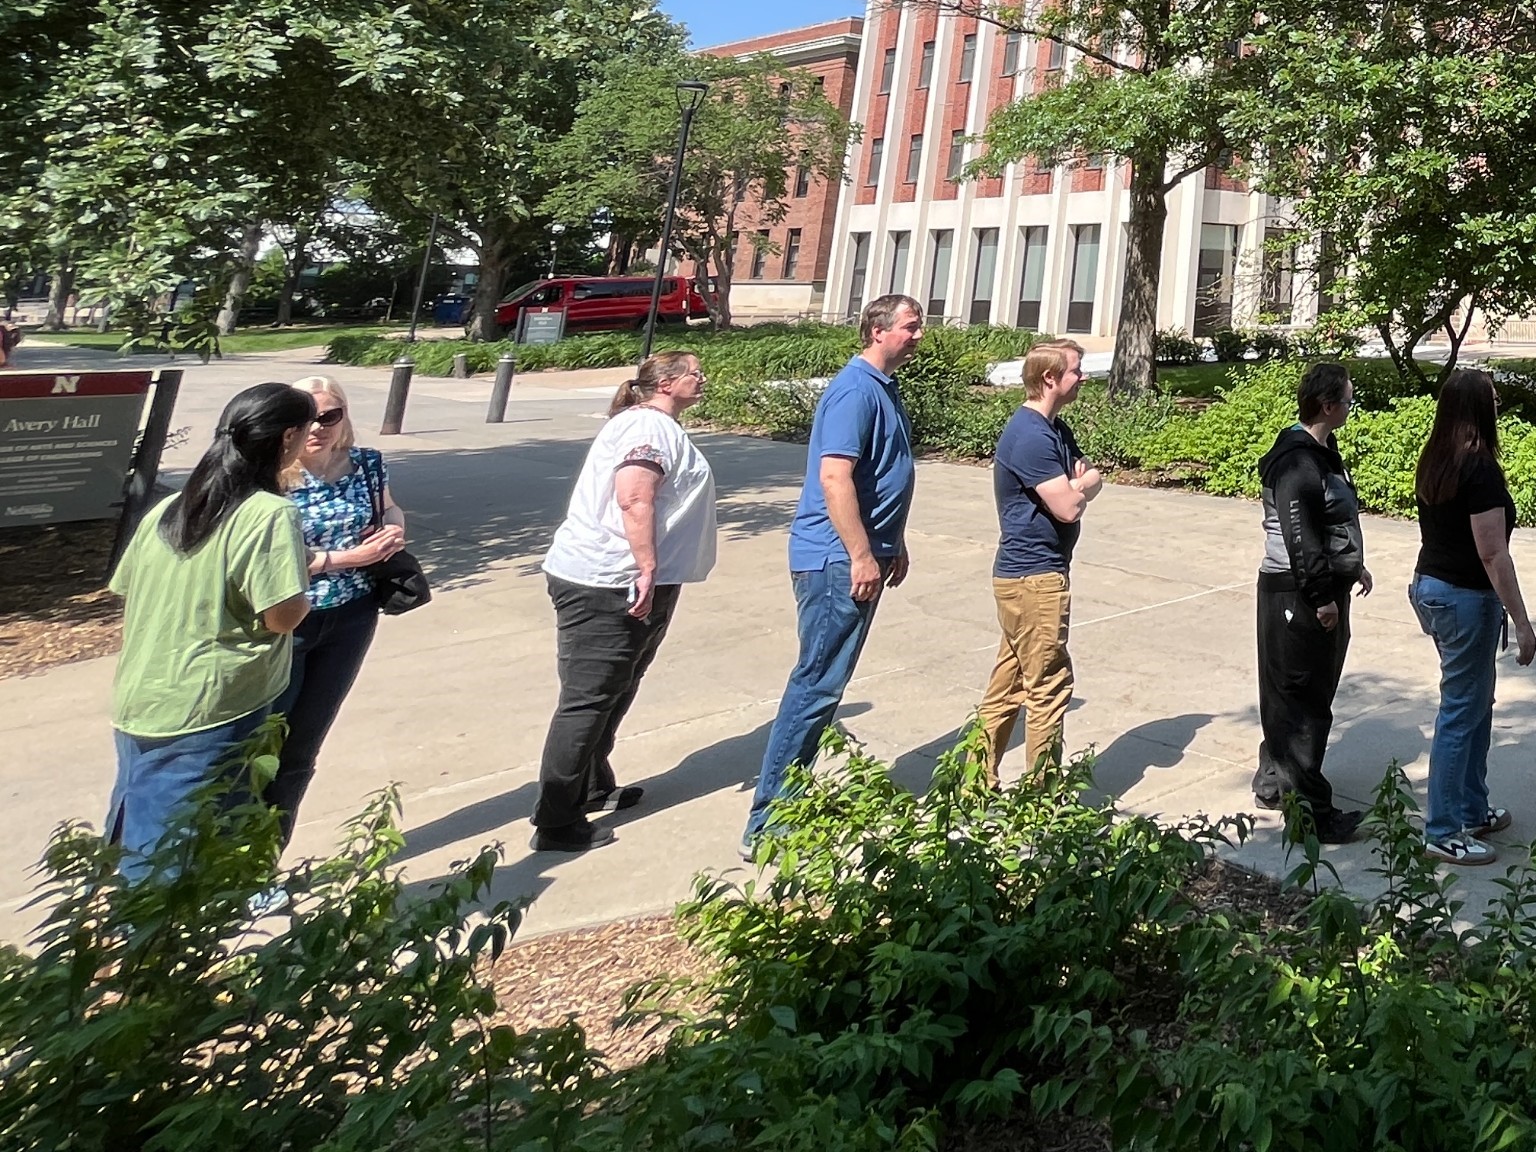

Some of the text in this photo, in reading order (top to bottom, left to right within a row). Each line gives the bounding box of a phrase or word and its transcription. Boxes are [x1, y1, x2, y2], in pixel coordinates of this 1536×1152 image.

[51, 375, 80, 394] N
[2, 414, 101, 433] Avery Hall
[1289, 499, 1302, 544] LINUS
